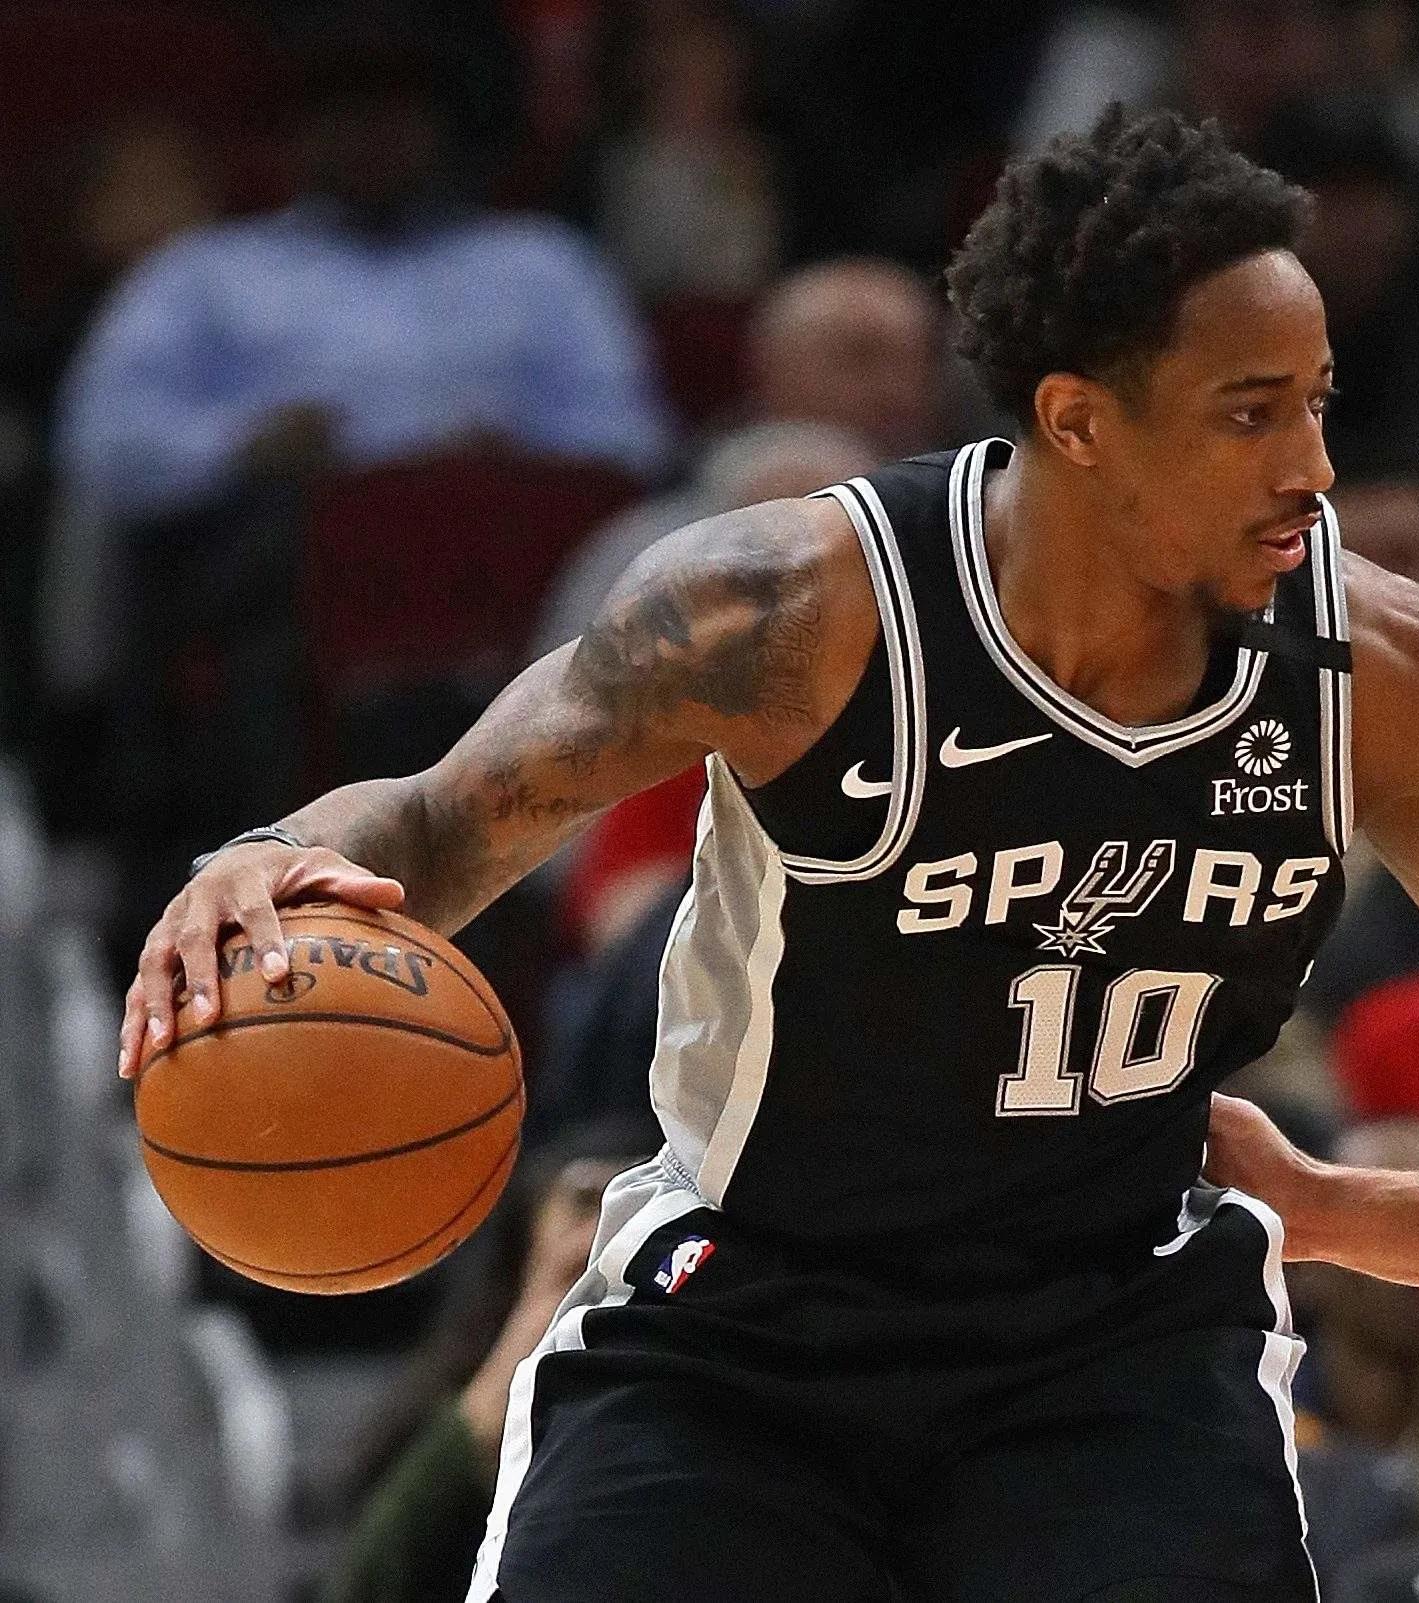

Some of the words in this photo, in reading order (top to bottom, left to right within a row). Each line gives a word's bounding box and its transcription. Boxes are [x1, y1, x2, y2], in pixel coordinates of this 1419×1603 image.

[1210, 778, 1309, 816] Frost
[896, 839, 1330, 957] SPURS
[995, 963, 1224, 1117] 10
